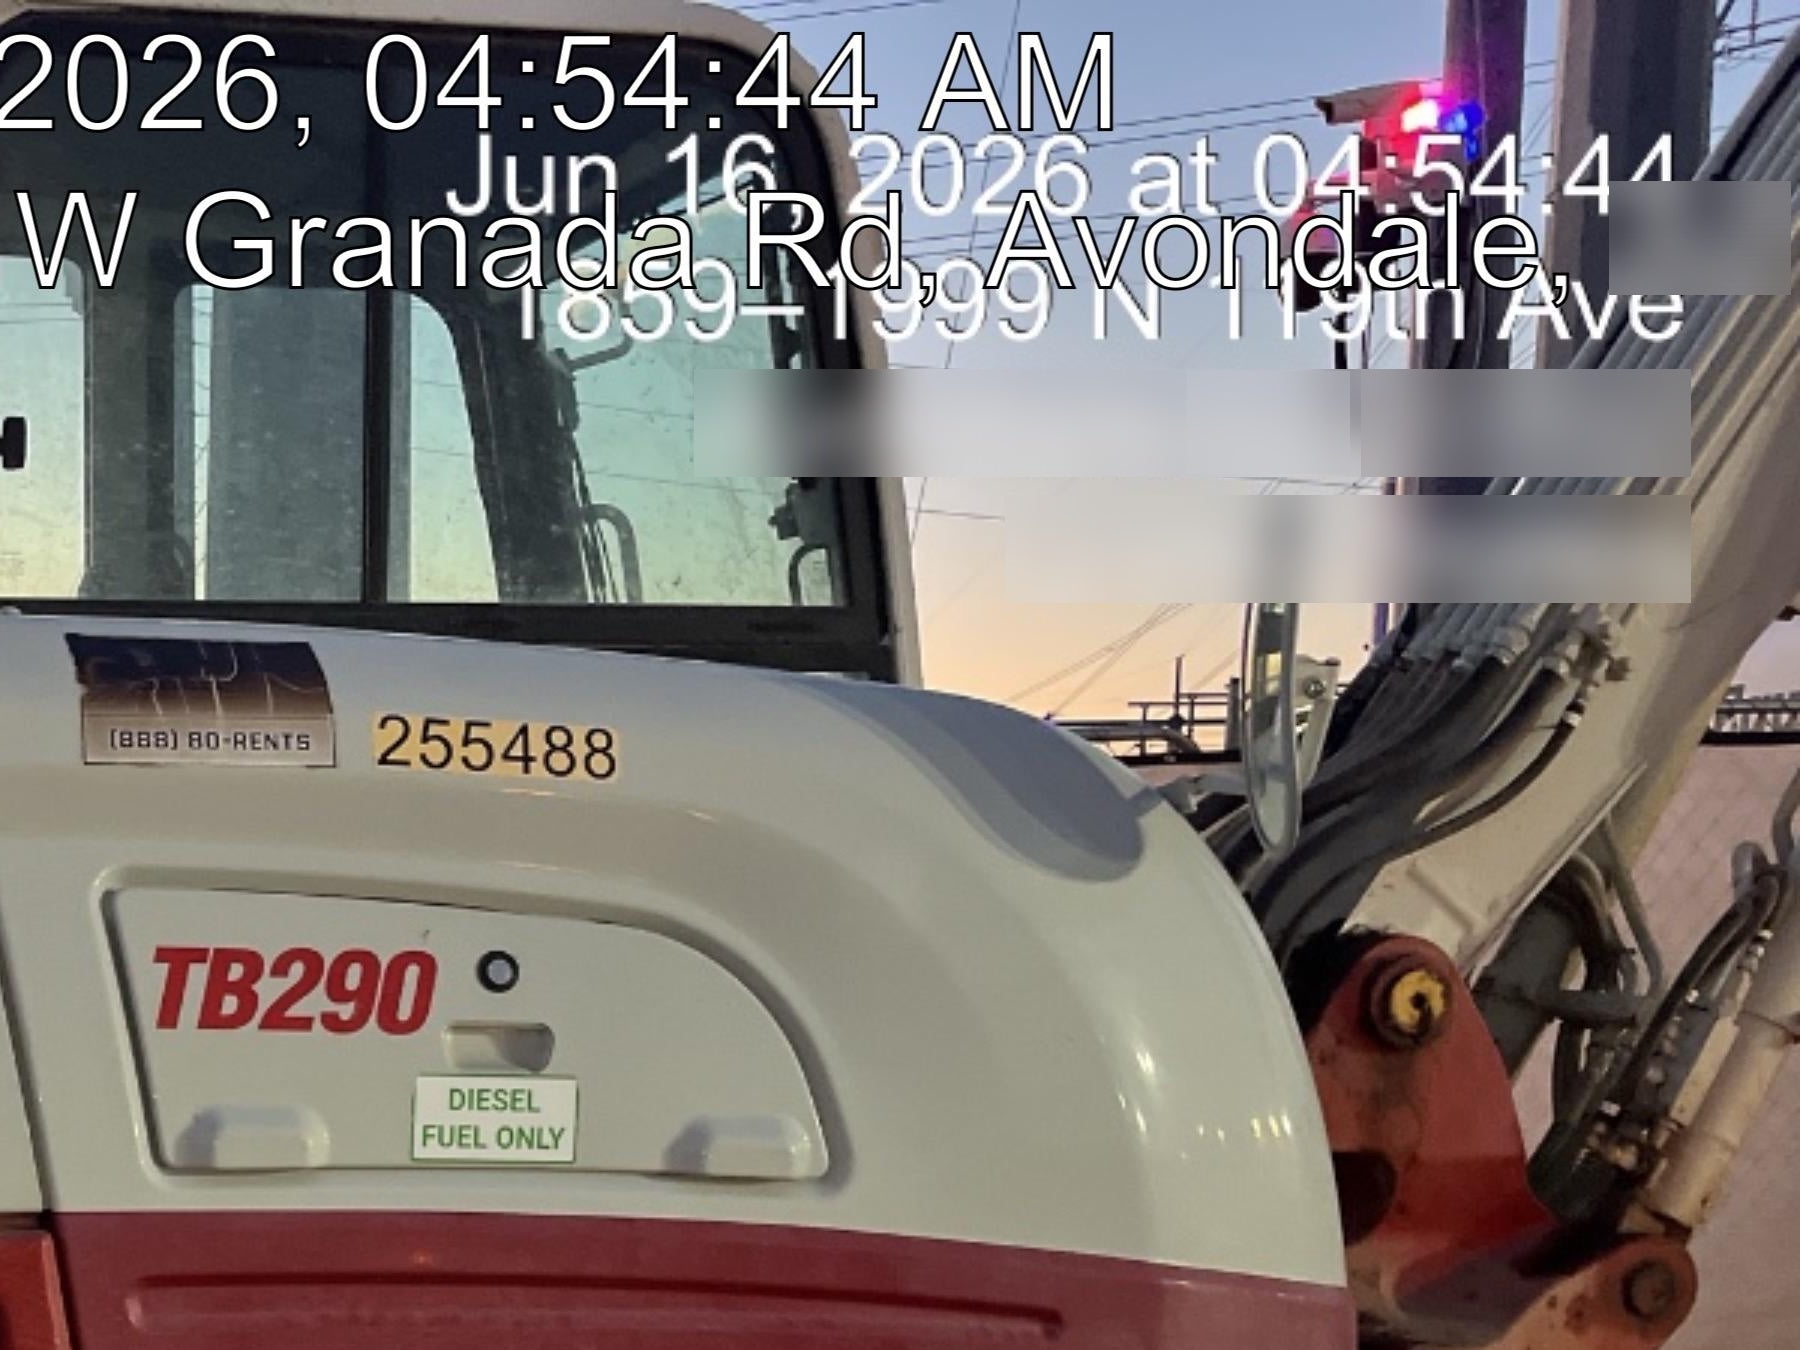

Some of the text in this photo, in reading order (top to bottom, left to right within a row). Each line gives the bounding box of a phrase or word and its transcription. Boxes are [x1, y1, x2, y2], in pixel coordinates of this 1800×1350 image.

[110, 728, 178, 751] (888)
[376, 713, 617, 780] 255488
[152, 946, 439, 1035] TB290
[448, 1087, 541, 1113] DIESEL
[421, 1124, 566, 1150] FUEL ONLY
